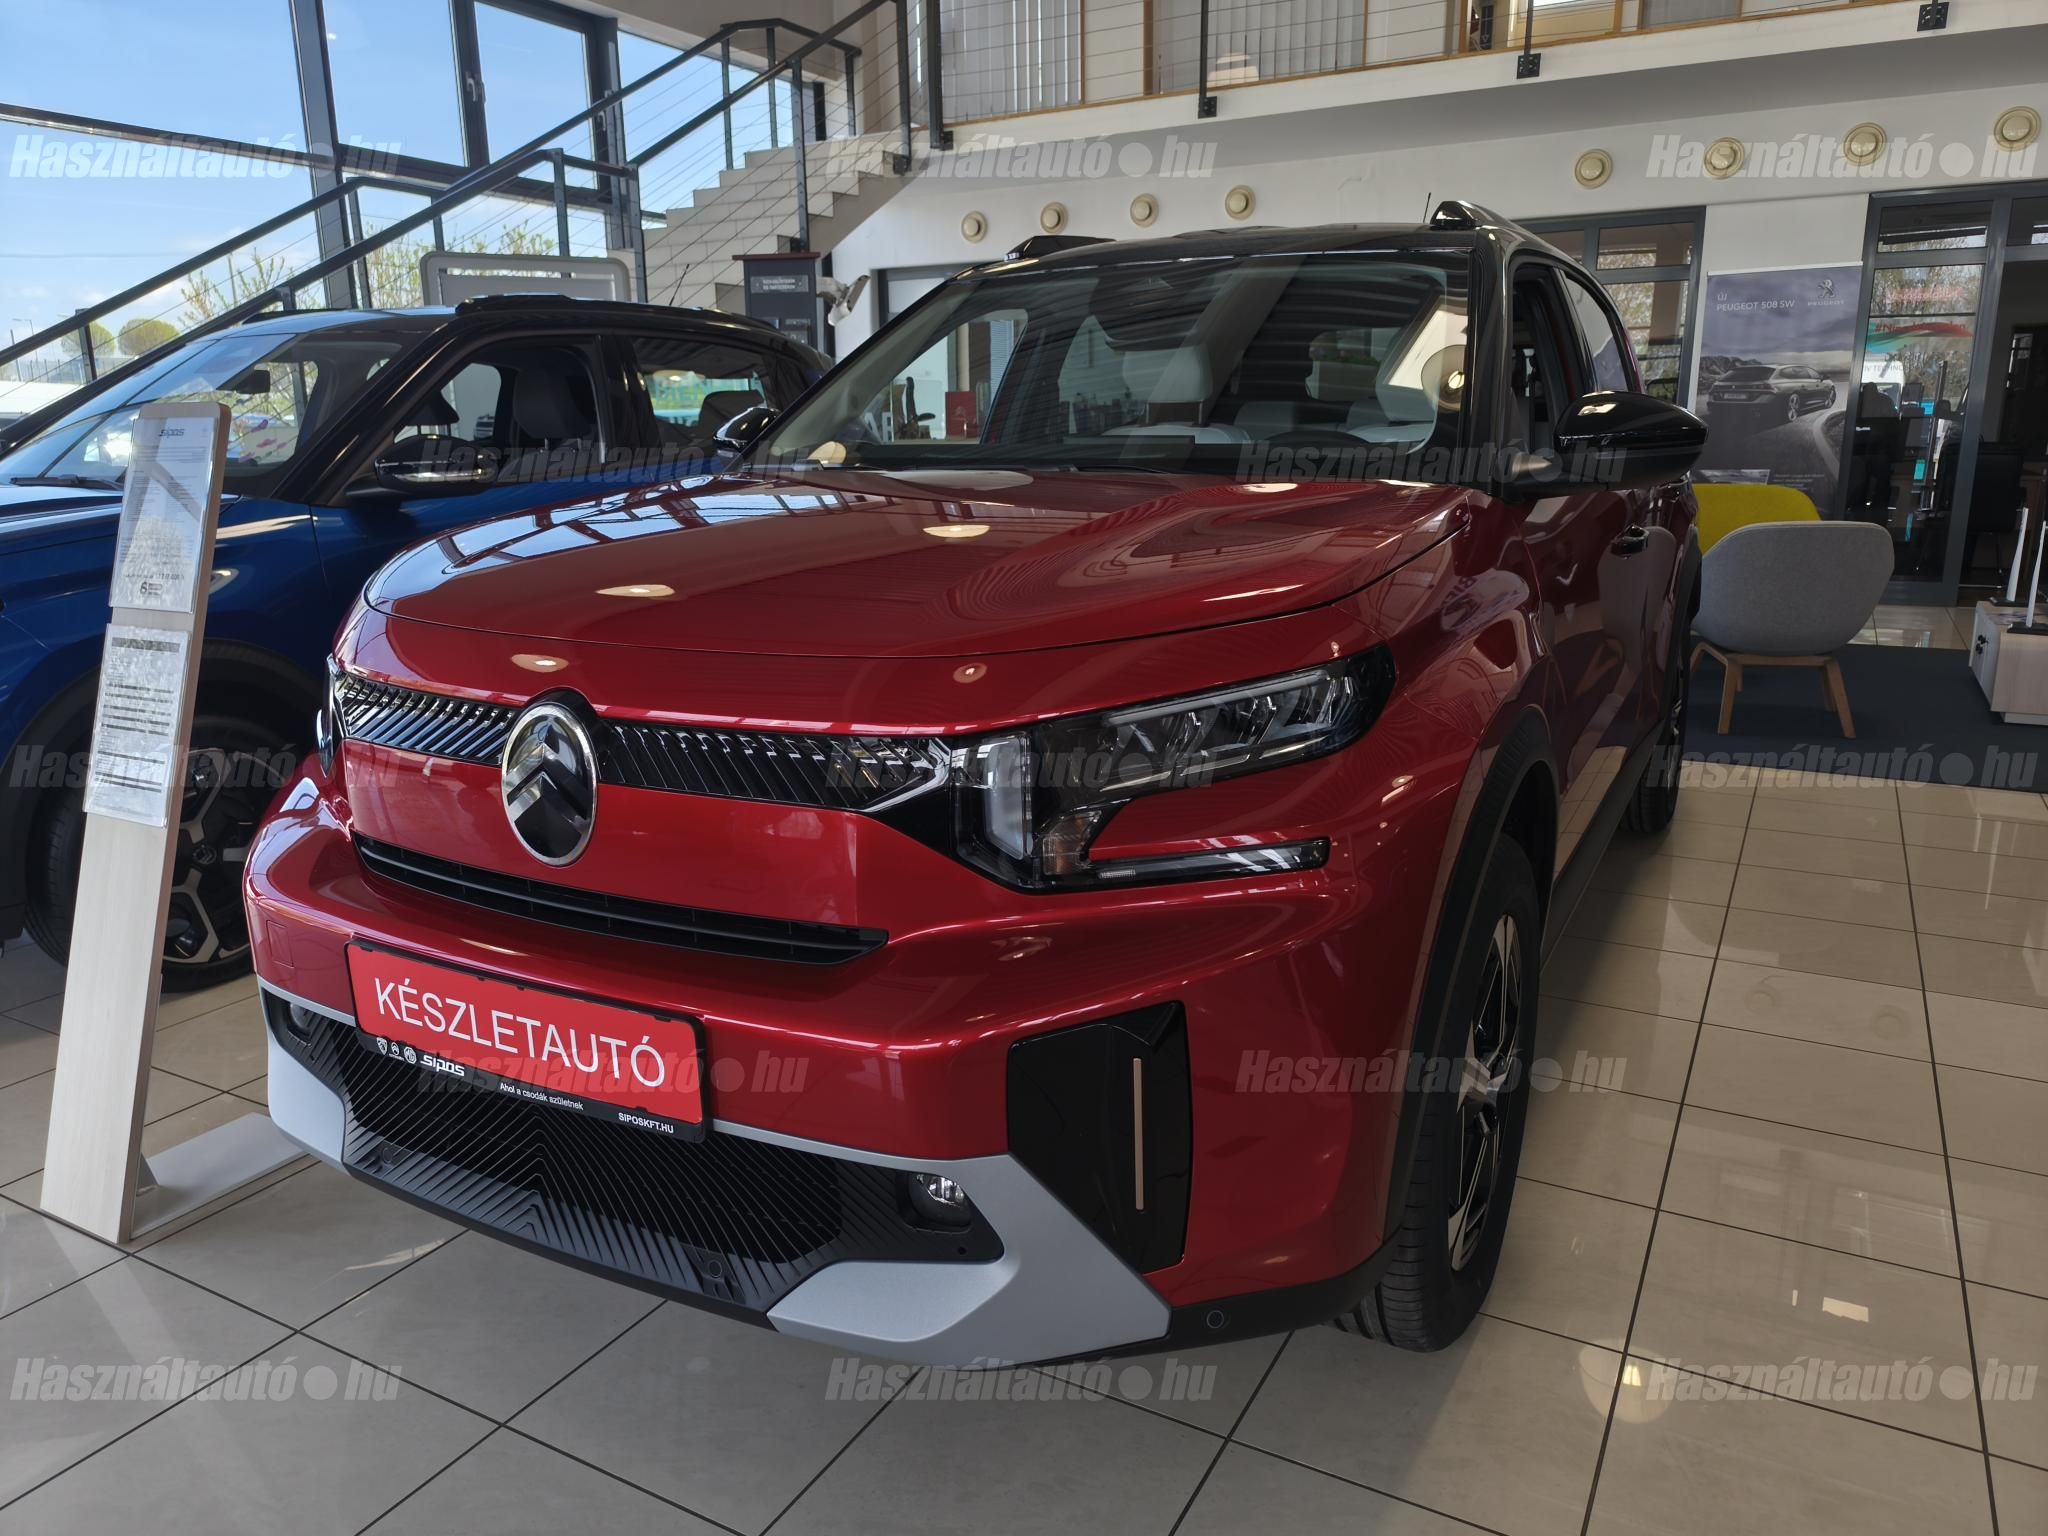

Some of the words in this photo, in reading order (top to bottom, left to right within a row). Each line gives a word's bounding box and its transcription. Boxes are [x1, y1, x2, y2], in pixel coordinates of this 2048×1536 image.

[1716, 302, 1759, 312] PEUGEOT
[1761, 300, 1778, 309] 508
[1780, 299, 1795, 308] SW
[375, 978, 665, 1087] KÉSZLETAUTÓ
[421, 1055, 465, 1077] sipos
[500, 1082, 515, 1094] Ahol
[522, 1090, 548, 1102] csodák
[549, 1096, 584, 1111] születnek
[618, 1112, 674, 1133] SIPOSKFT.HU
